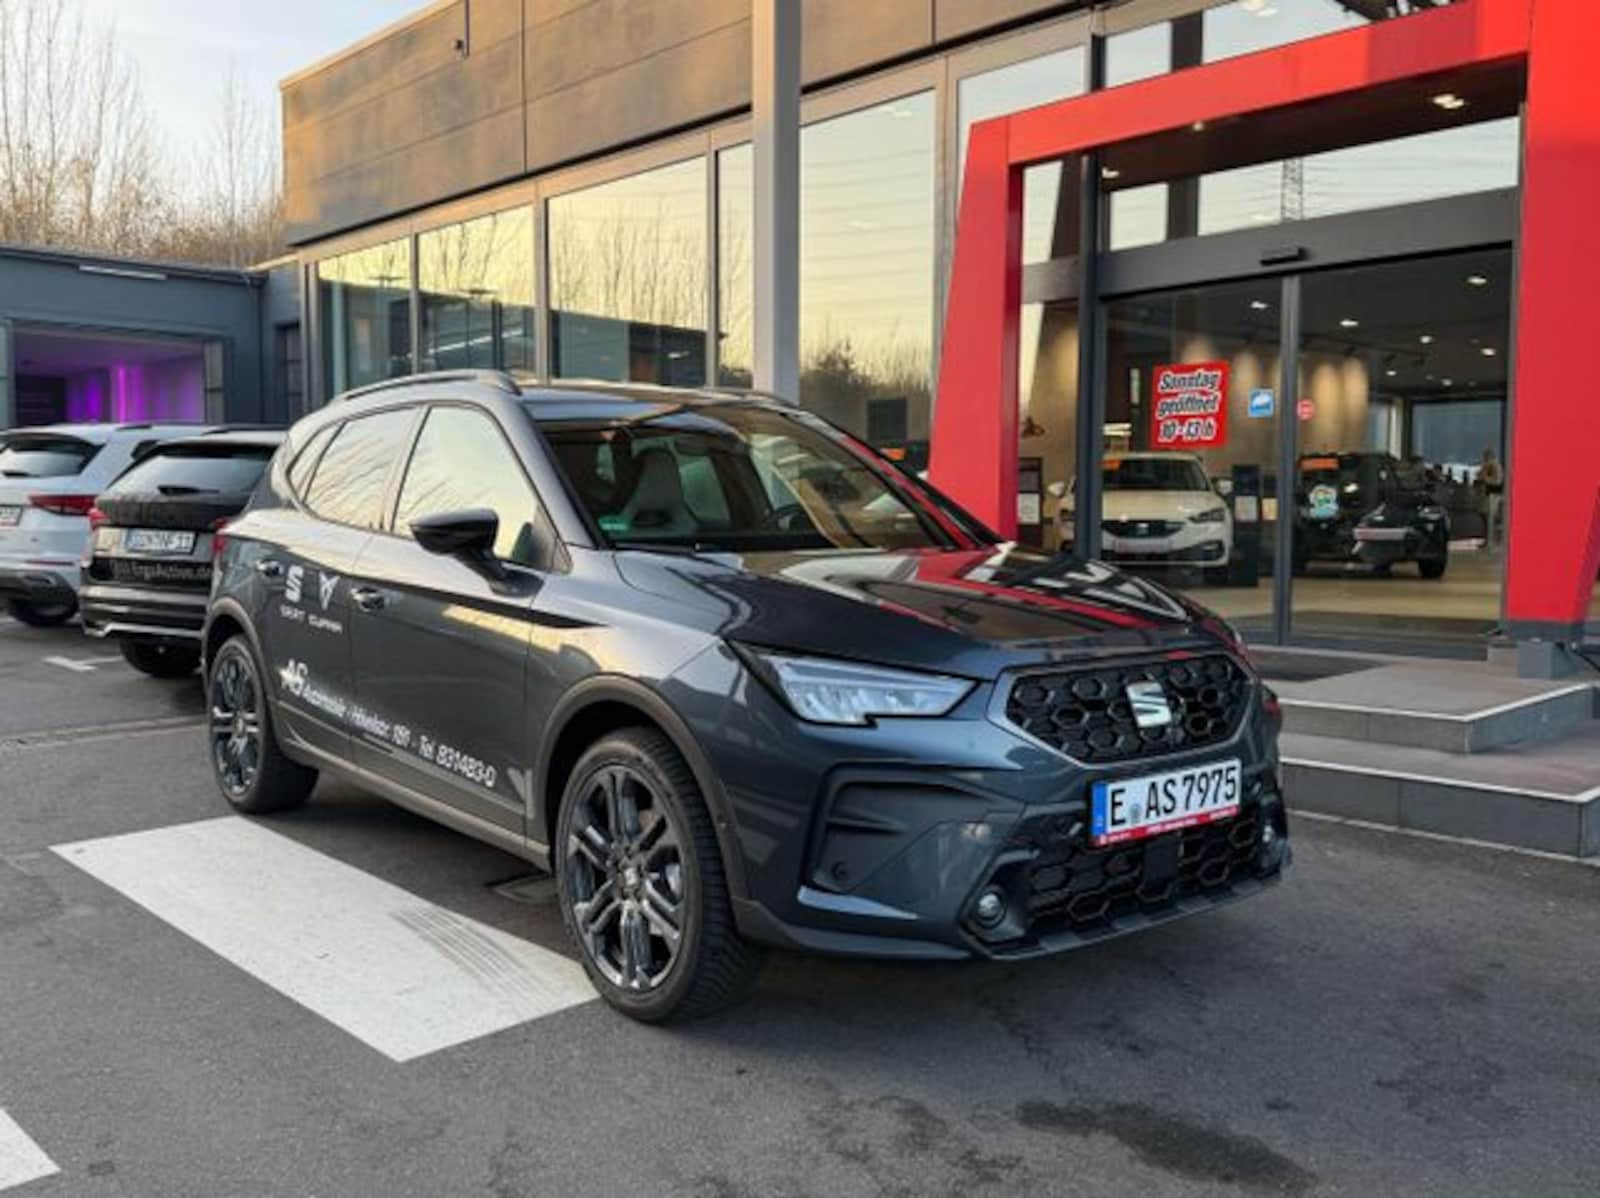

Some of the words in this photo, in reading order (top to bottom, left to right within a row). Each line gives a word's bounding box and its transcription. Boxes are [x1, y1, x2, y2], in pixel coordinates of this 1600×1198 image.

[1159, 371, 1220, 392] Sonntag
[1157, 393, 1219, 417] geöffnet
[1110, 788, 1126, 827] E
[1145, 778, 1177, 819] AS
[1182, 766, 1237, 811] 7975
